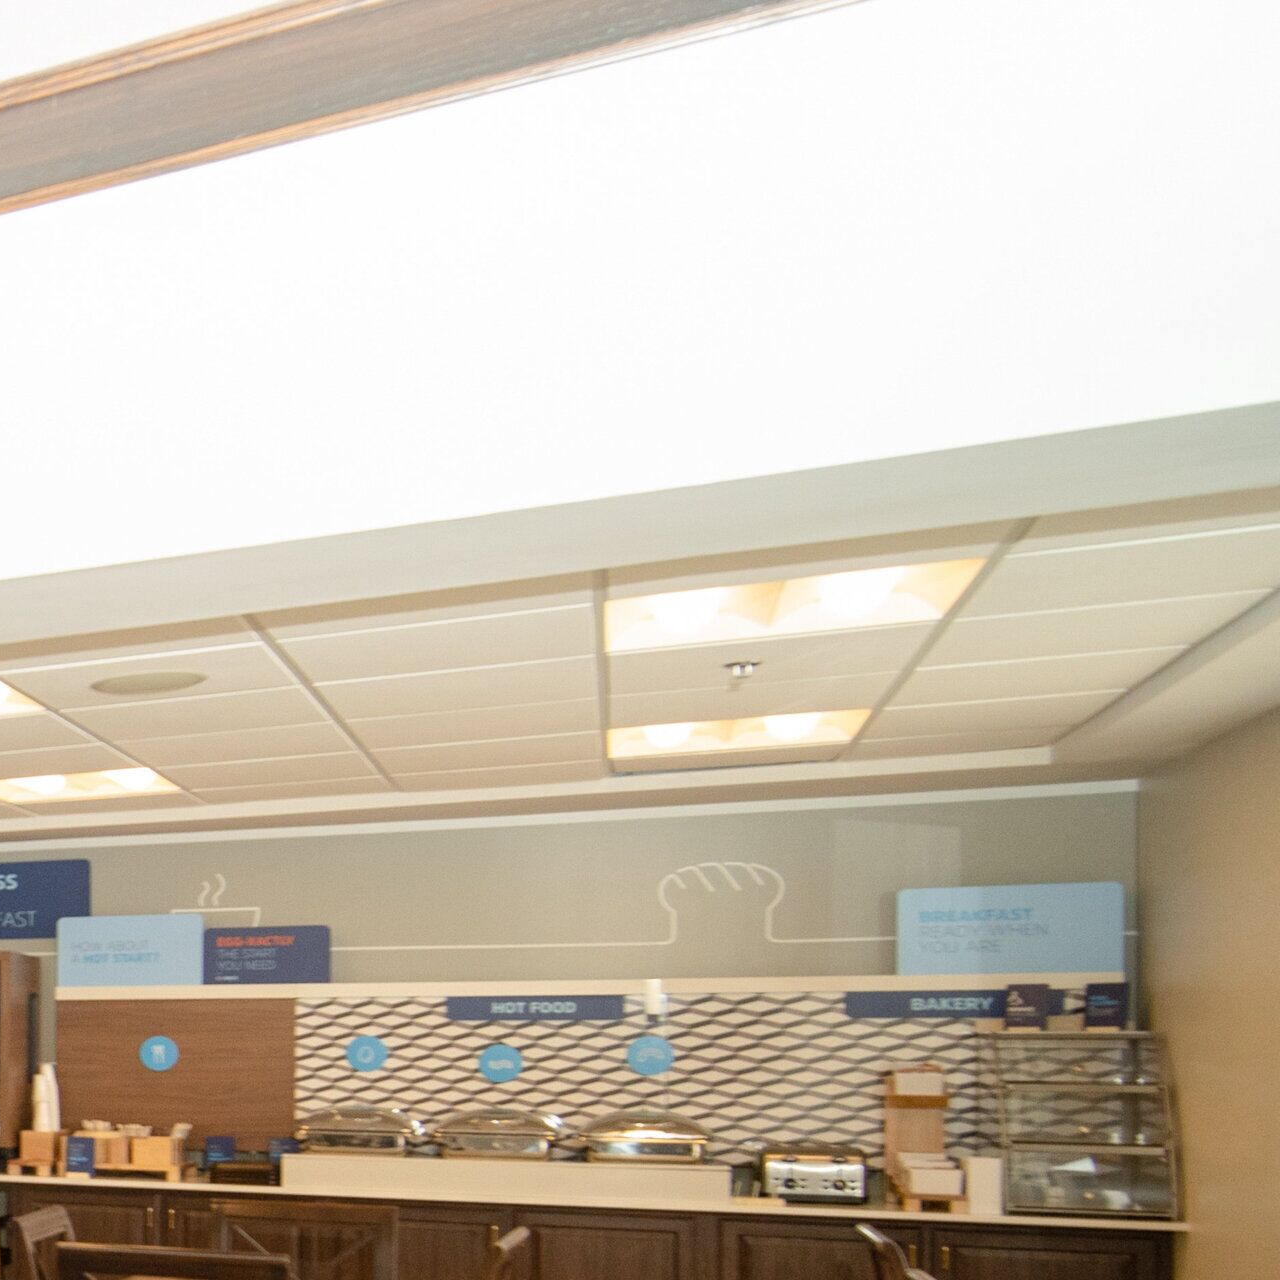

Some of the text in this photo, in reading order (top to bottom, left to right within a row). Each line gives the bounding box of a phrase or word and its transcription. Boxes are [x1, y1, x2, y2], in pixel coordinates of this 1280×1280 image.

[919, 908, 1034, 922] BREAKFAST
[491, 1001, 577, 1014] HOT FOOD
[910, 997, 994, 1012] BAKERY
